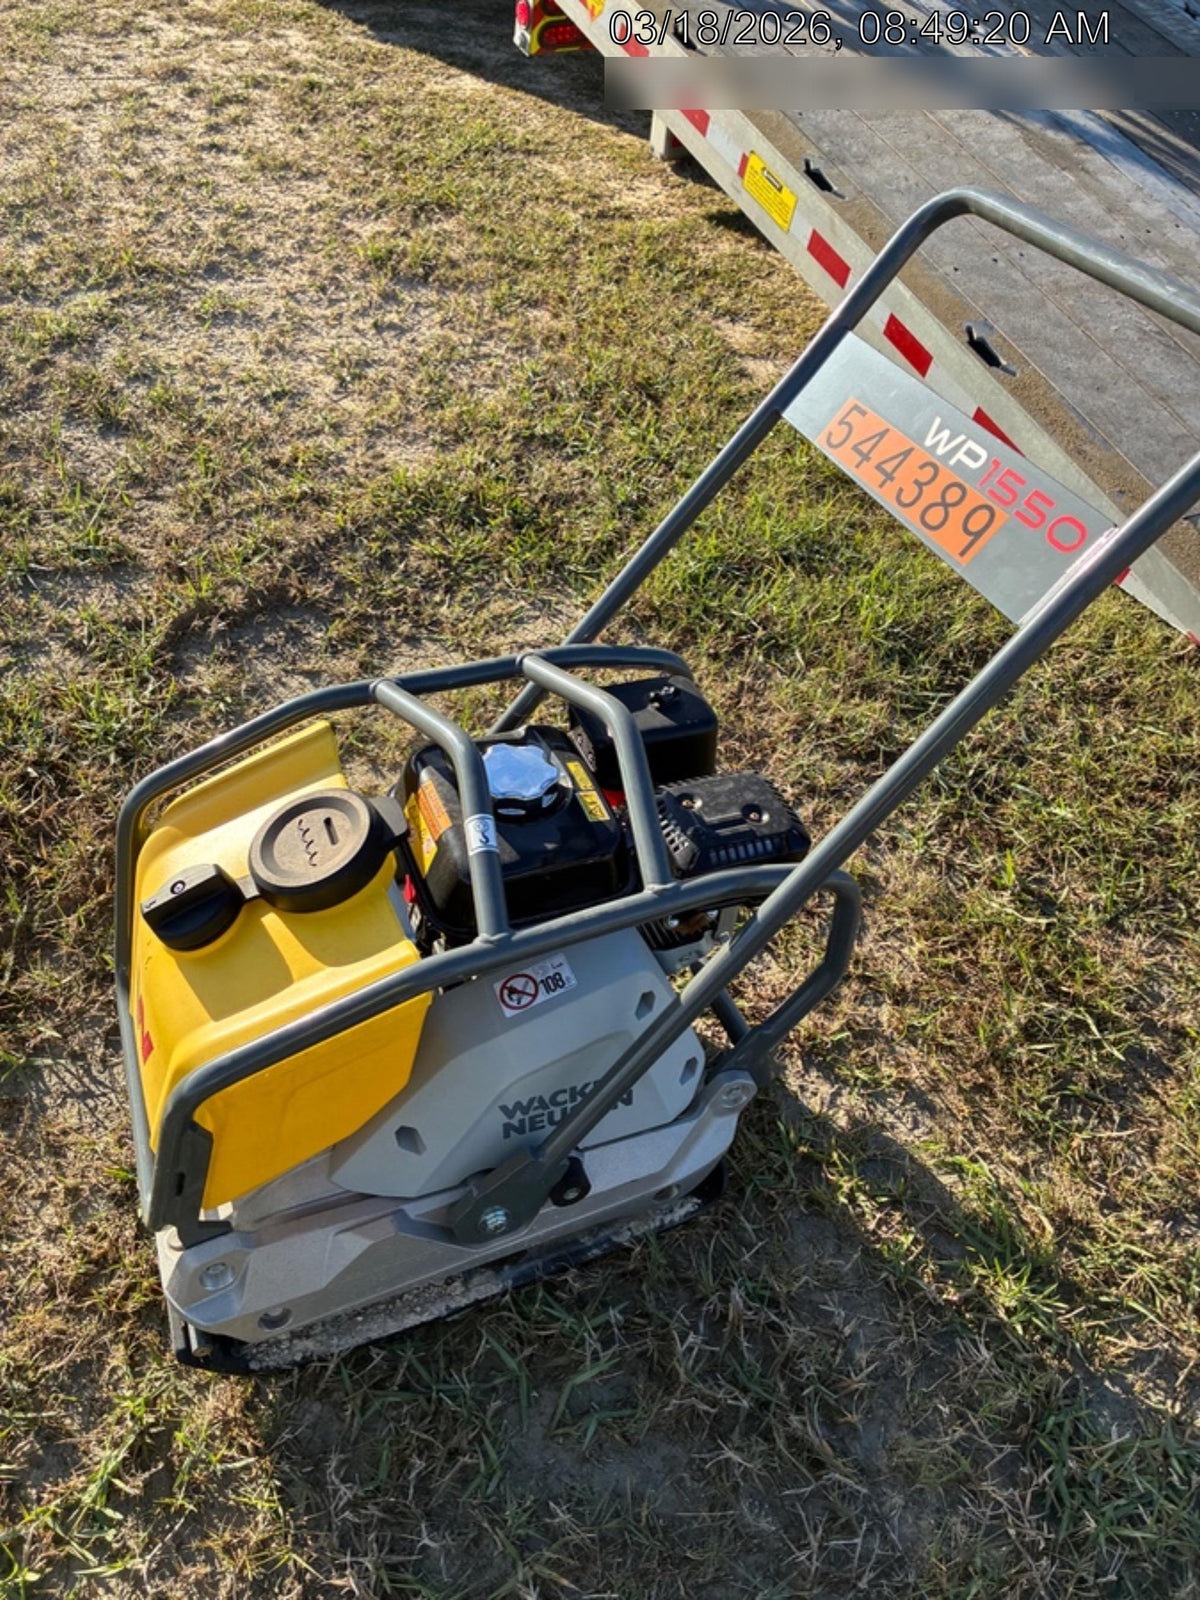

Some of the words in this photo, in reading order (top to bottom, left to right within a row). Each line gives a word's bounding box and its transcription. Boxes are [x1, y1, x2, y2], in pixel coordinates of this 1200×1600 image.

[825, 404, 996, 557] 544389
[923, 416, 1088, 553] WP1550
[539, 972, 566, 995] 108
[498, 1079, 601, 1120] WACK
